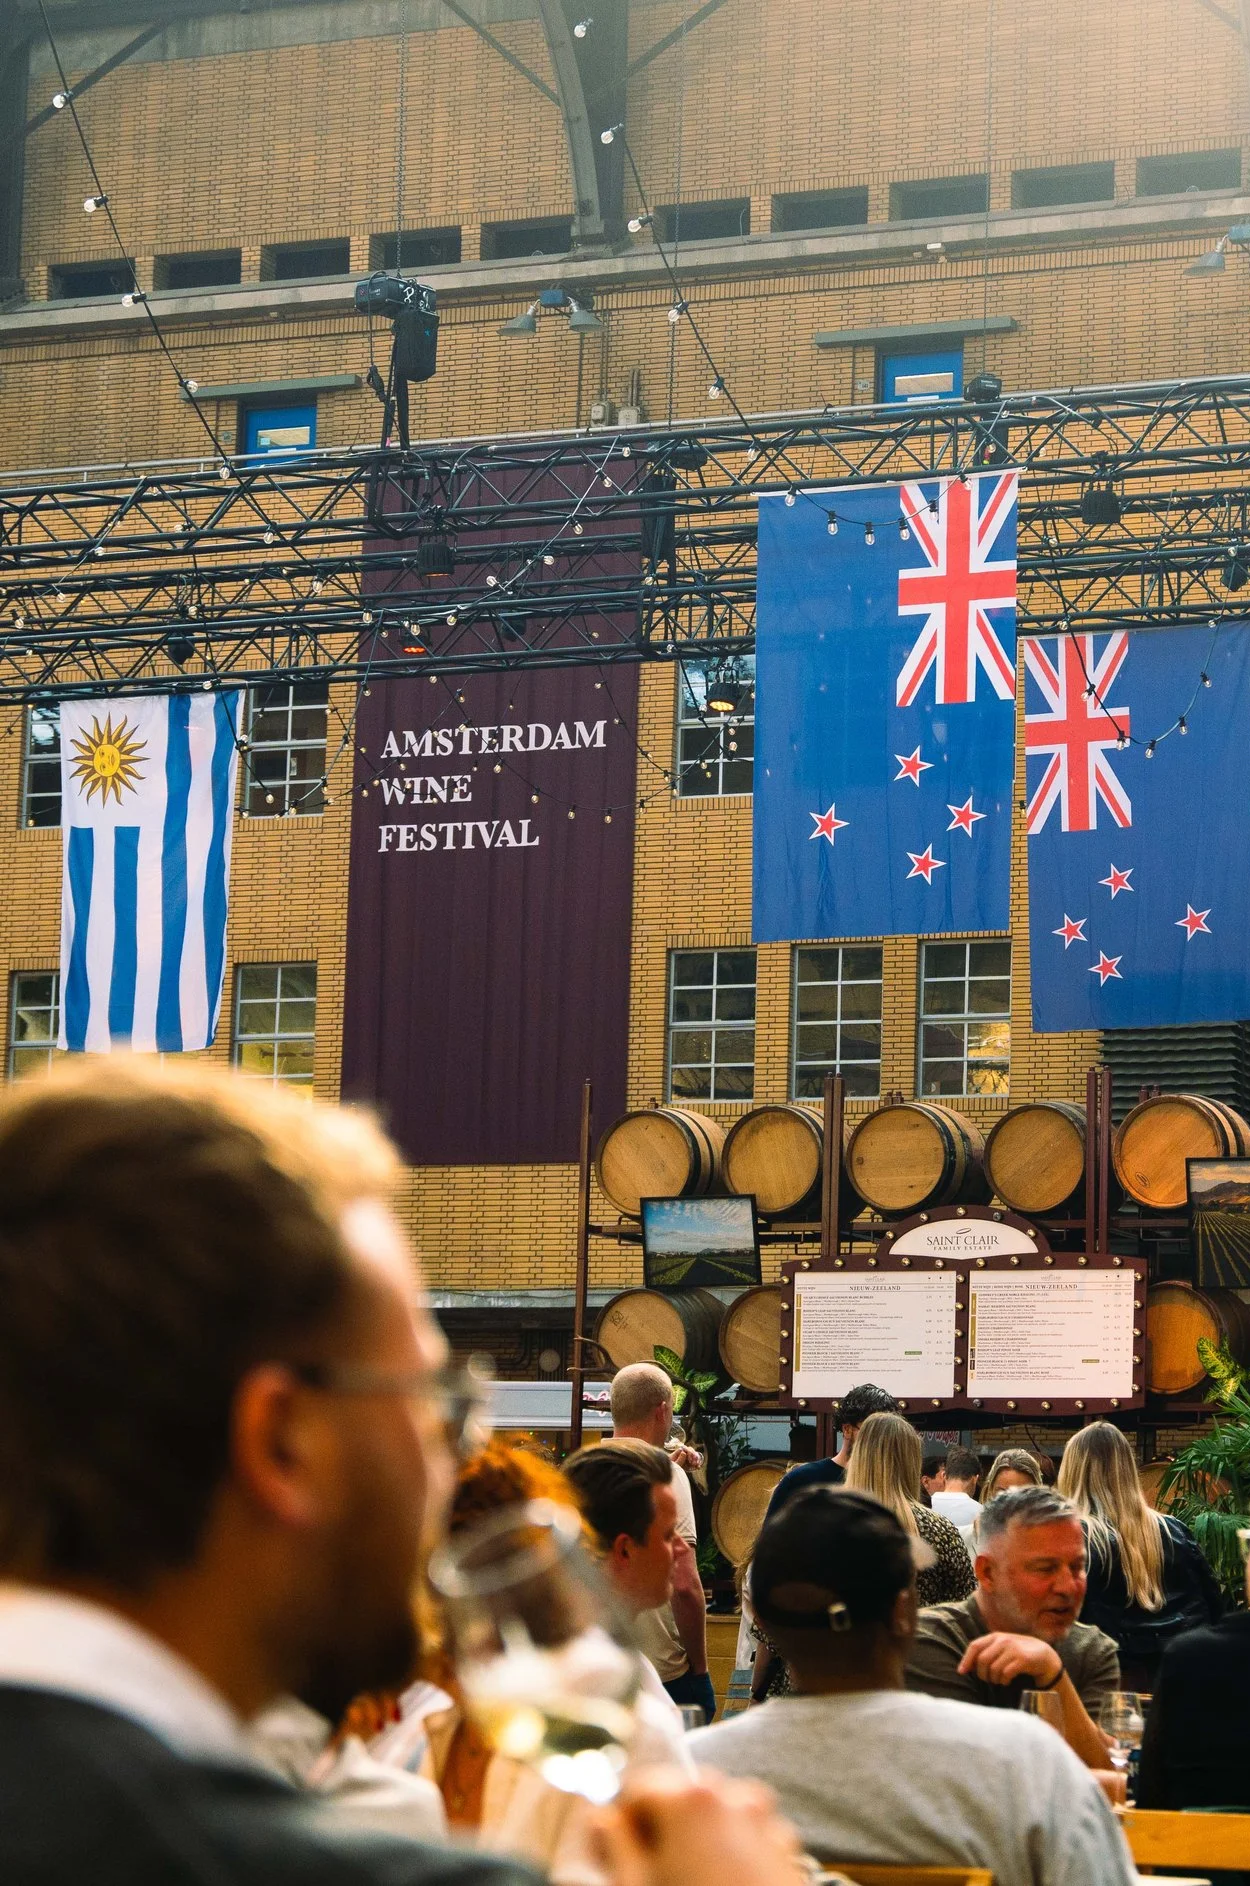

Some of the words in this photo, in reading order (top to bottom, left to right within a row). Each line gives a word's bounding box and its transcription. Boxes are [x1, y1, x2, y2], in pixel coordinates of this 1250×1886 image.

[381, 720, 607, 758] AMSTERDAM
[380, 774, 472, 806] WINE
[377, 819, 540, 853] FESTIVAL
[926, 1235, 961, 1245] SAINT
[963, 1235, 999, 1245] CLAIR
